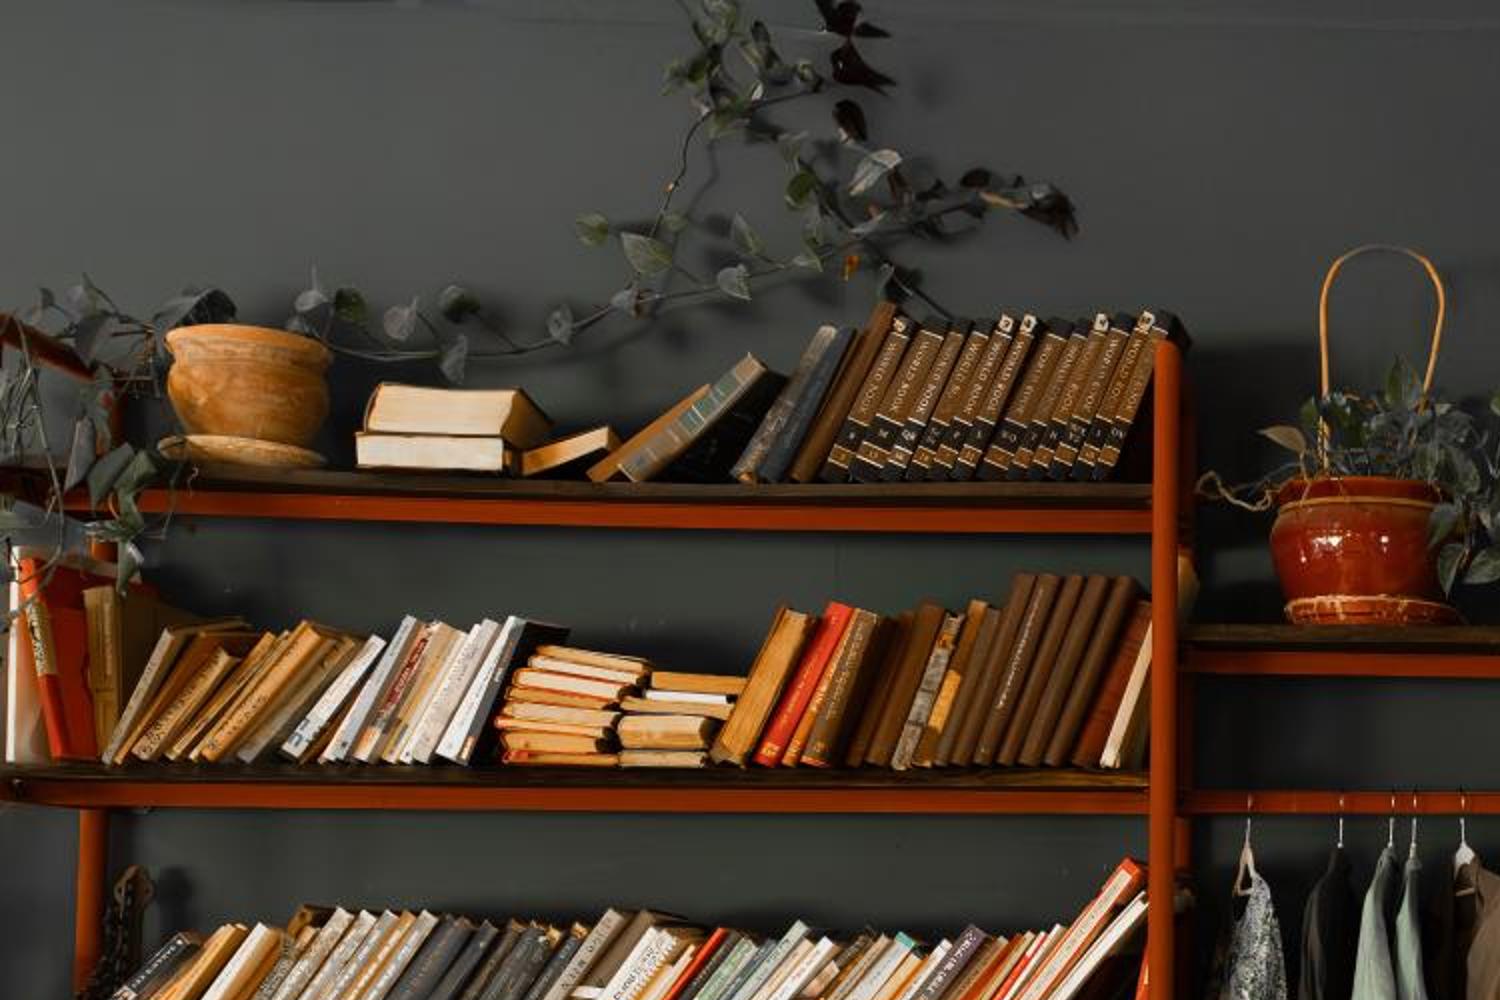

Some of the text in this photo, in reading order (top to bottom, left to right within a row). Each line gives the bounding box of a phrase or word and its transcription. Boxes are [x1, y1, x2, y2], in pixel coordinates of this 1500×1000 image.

[903, 339, 929, 381] WORLD
[954, 341, 980, 383] WORLD
[962, 340, 1001, 414] WORLD BOOK
[999, 339, 1024, 382] WORLD
[1118, 337, 1142, 379] WORLD
[914, 382, 936, 415] BOOK
